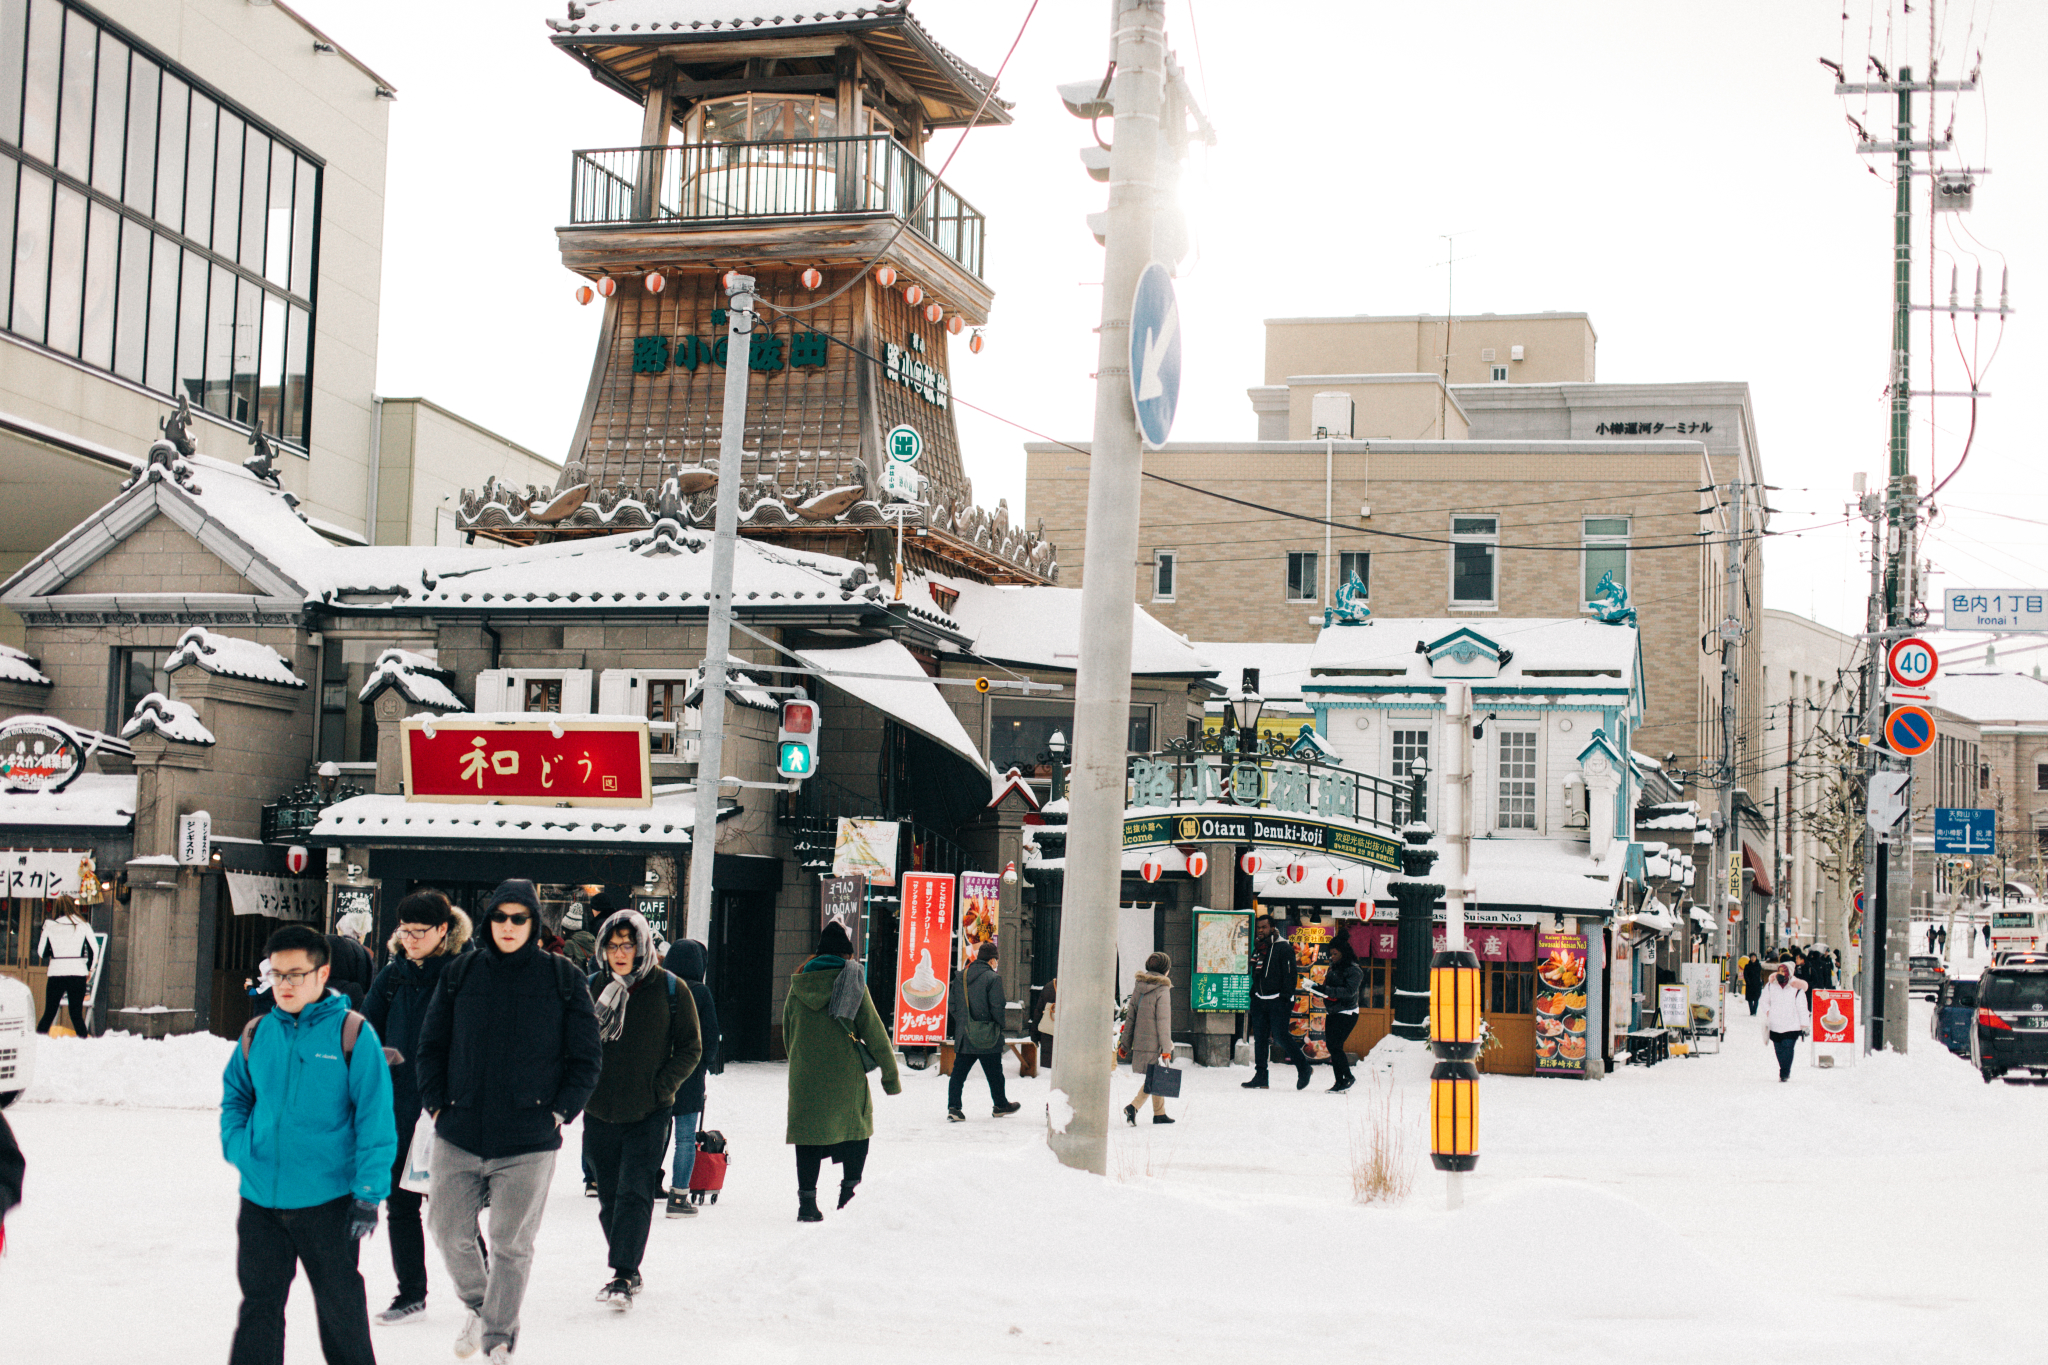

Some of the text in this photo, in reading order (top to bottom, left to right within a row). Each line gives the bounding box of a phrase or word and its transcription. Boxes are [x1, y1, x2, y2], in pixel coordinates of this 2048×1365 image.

[1595, 421, 1713, 435] 小樽運河ターミナル
[1977, 615, 2018, 625] Ironai 1
[1900, 651, 1928, 674] 40
[459, 736, 592, 789] 和どう
[1123, 822, 1163, 835] 出抜小路へ
[1202, 820, 1323, 847] Otaru Denuki-koji
[1730, 856, 1740, 899] バス出口
[965, 884, 999, 899] 海鮮食堂
[639, 901, 665, 913] CAFE
[1464, 911, 1522, 922] Suisan No3
[1561, 940, 1577, 949] Suisan
[1577, 941, 1587, 950] No3
